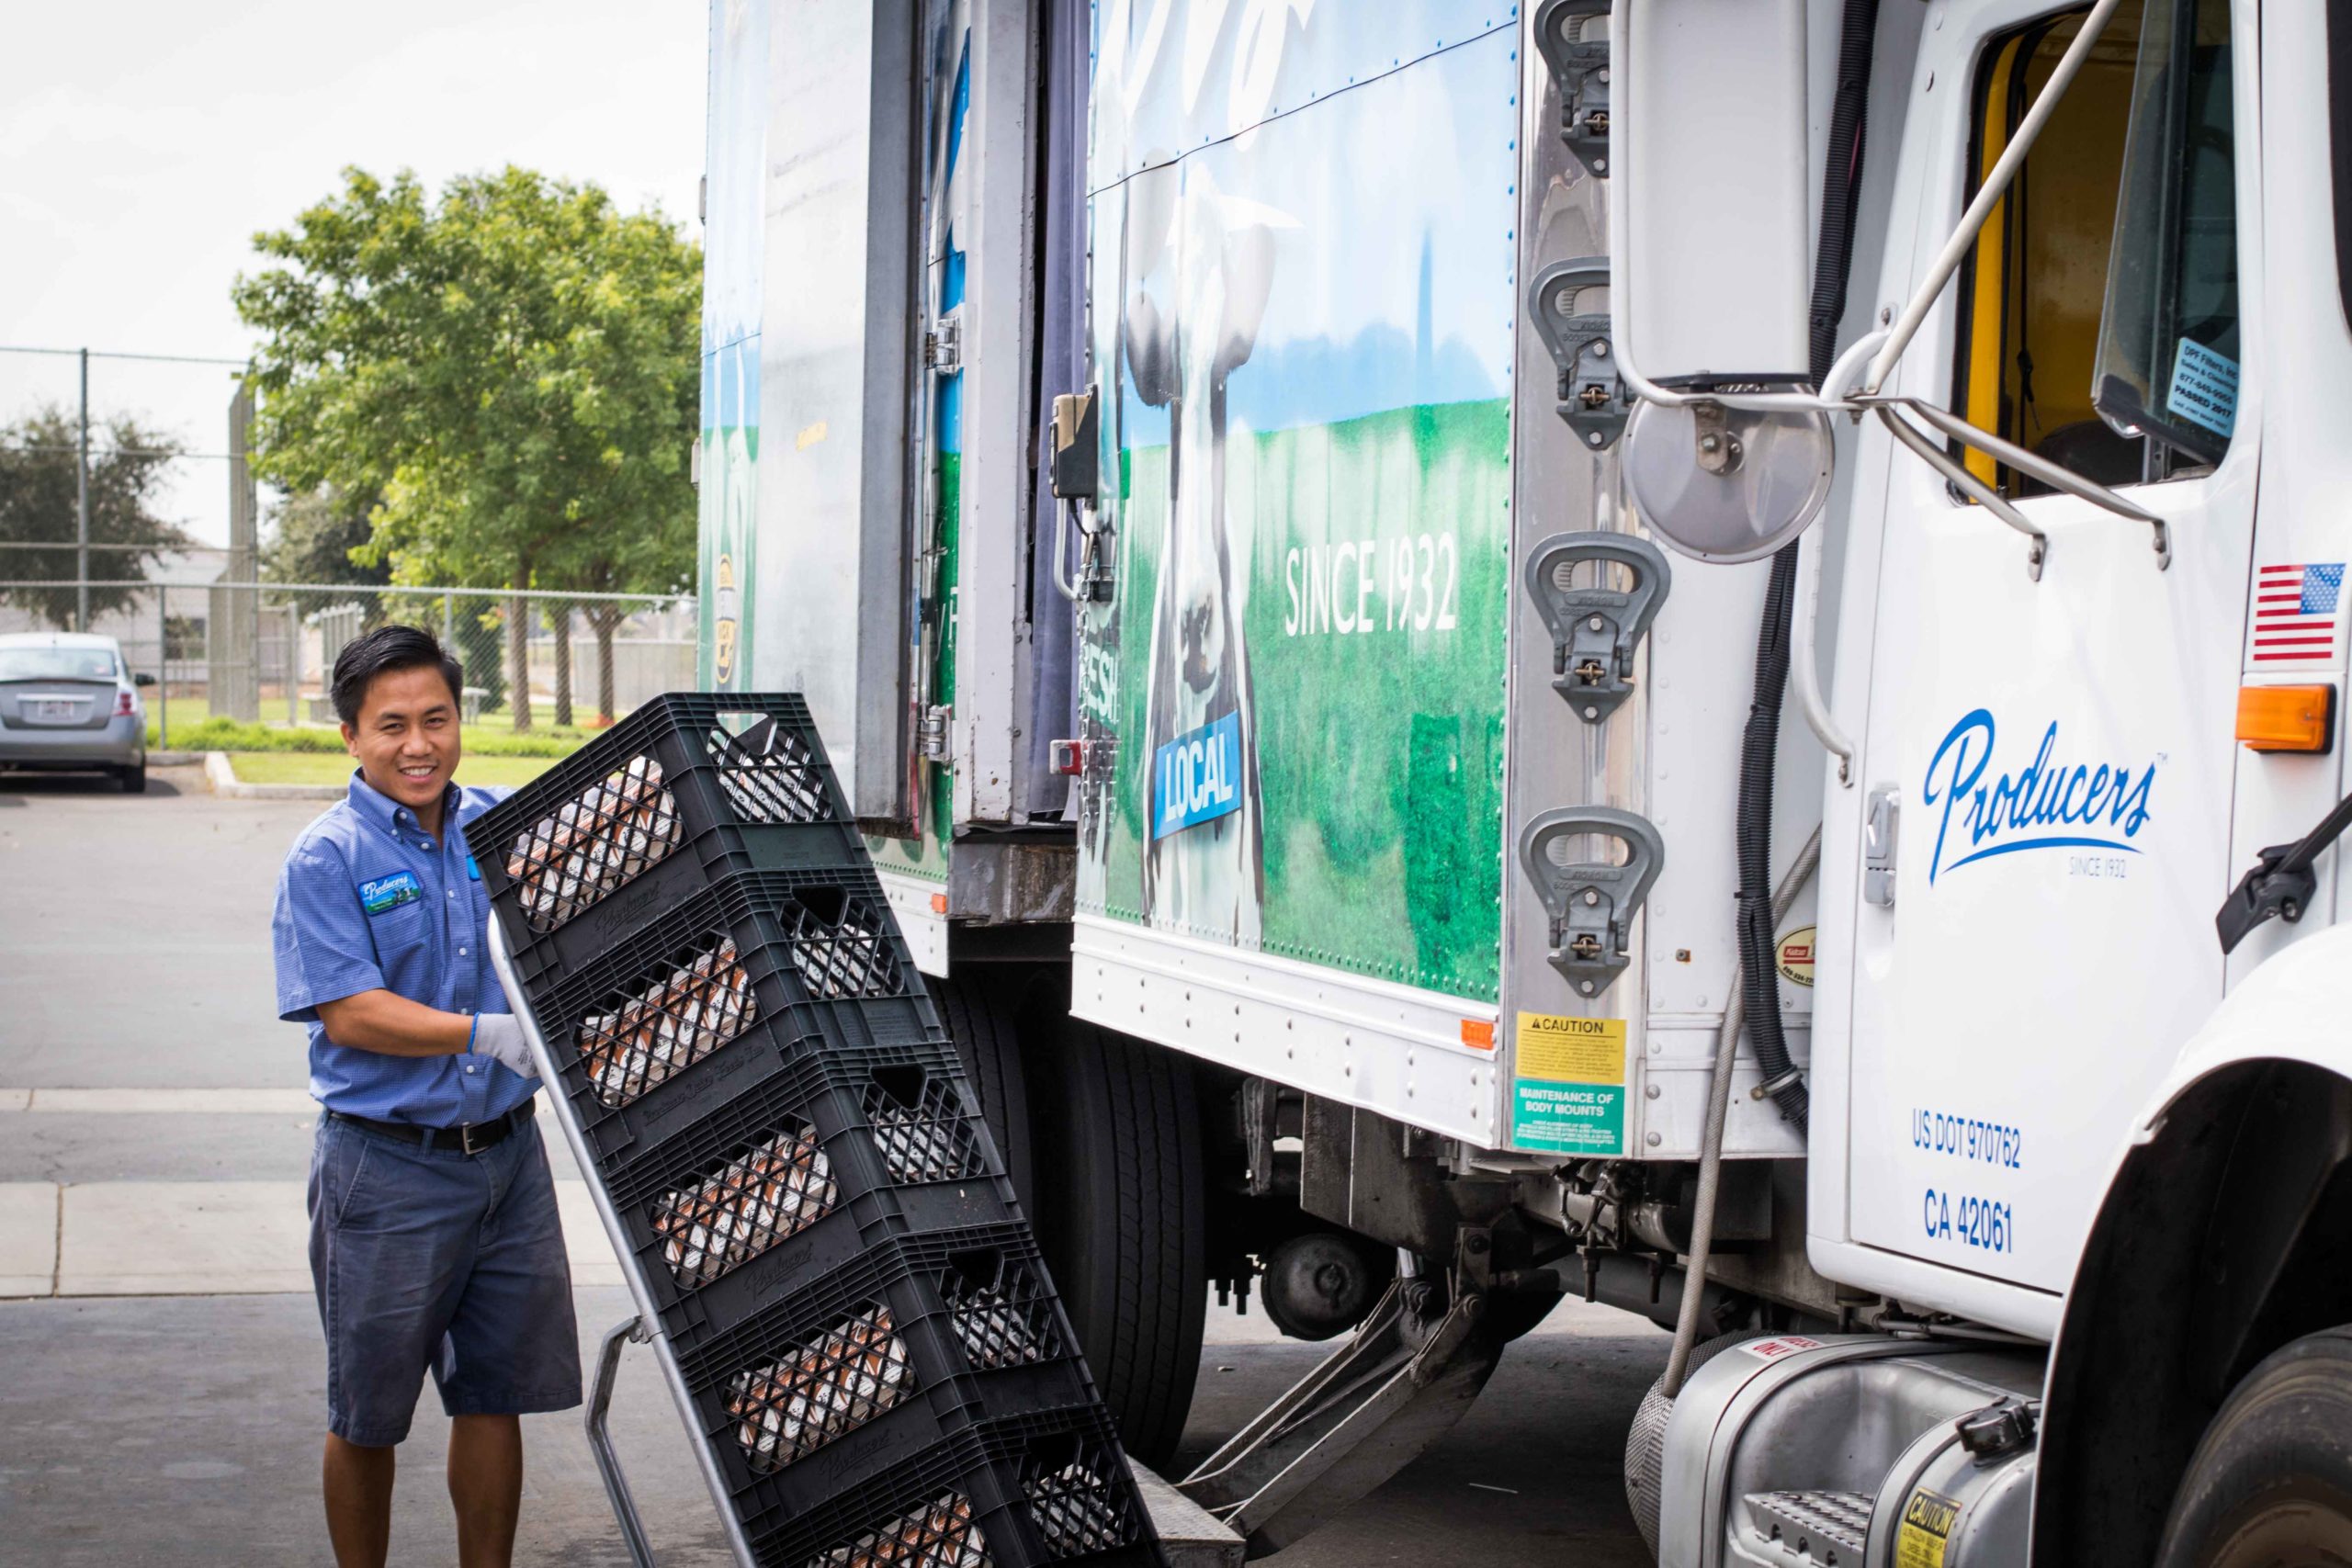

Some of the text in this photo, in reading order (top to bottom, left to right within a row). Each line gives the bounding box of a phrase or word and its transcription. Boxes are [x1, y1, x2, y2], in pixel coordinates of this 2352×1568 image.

[2184, 345, 2199, 358] DPF
[2175, 385, 2232, 418] PASSED 2017
[1285, 531, 1456, 637] SINCE 1932
[1165, 732, 1233, 823] LOCAL
[1923, 708, 2156, 889] Producers
[2069, 856, 2126, 878] SINCE 1932
[363, 875, 409, 901] Producers
[1543, 1018, 1604, 1034] CAUTION
[1520, 1088, 1614, 1104] MAINTENANCE OF
[1525, 1100, 1605, 1117] BODY MOUNTS
[1913, 1108, 2020, 1169] US DOT 970762
[1925, 1189, 2011, 1254] CA 42061
[1753, 1342, 1793, 1357] ONLY
[1908, 1495, 1955, 1535] CAUTION
